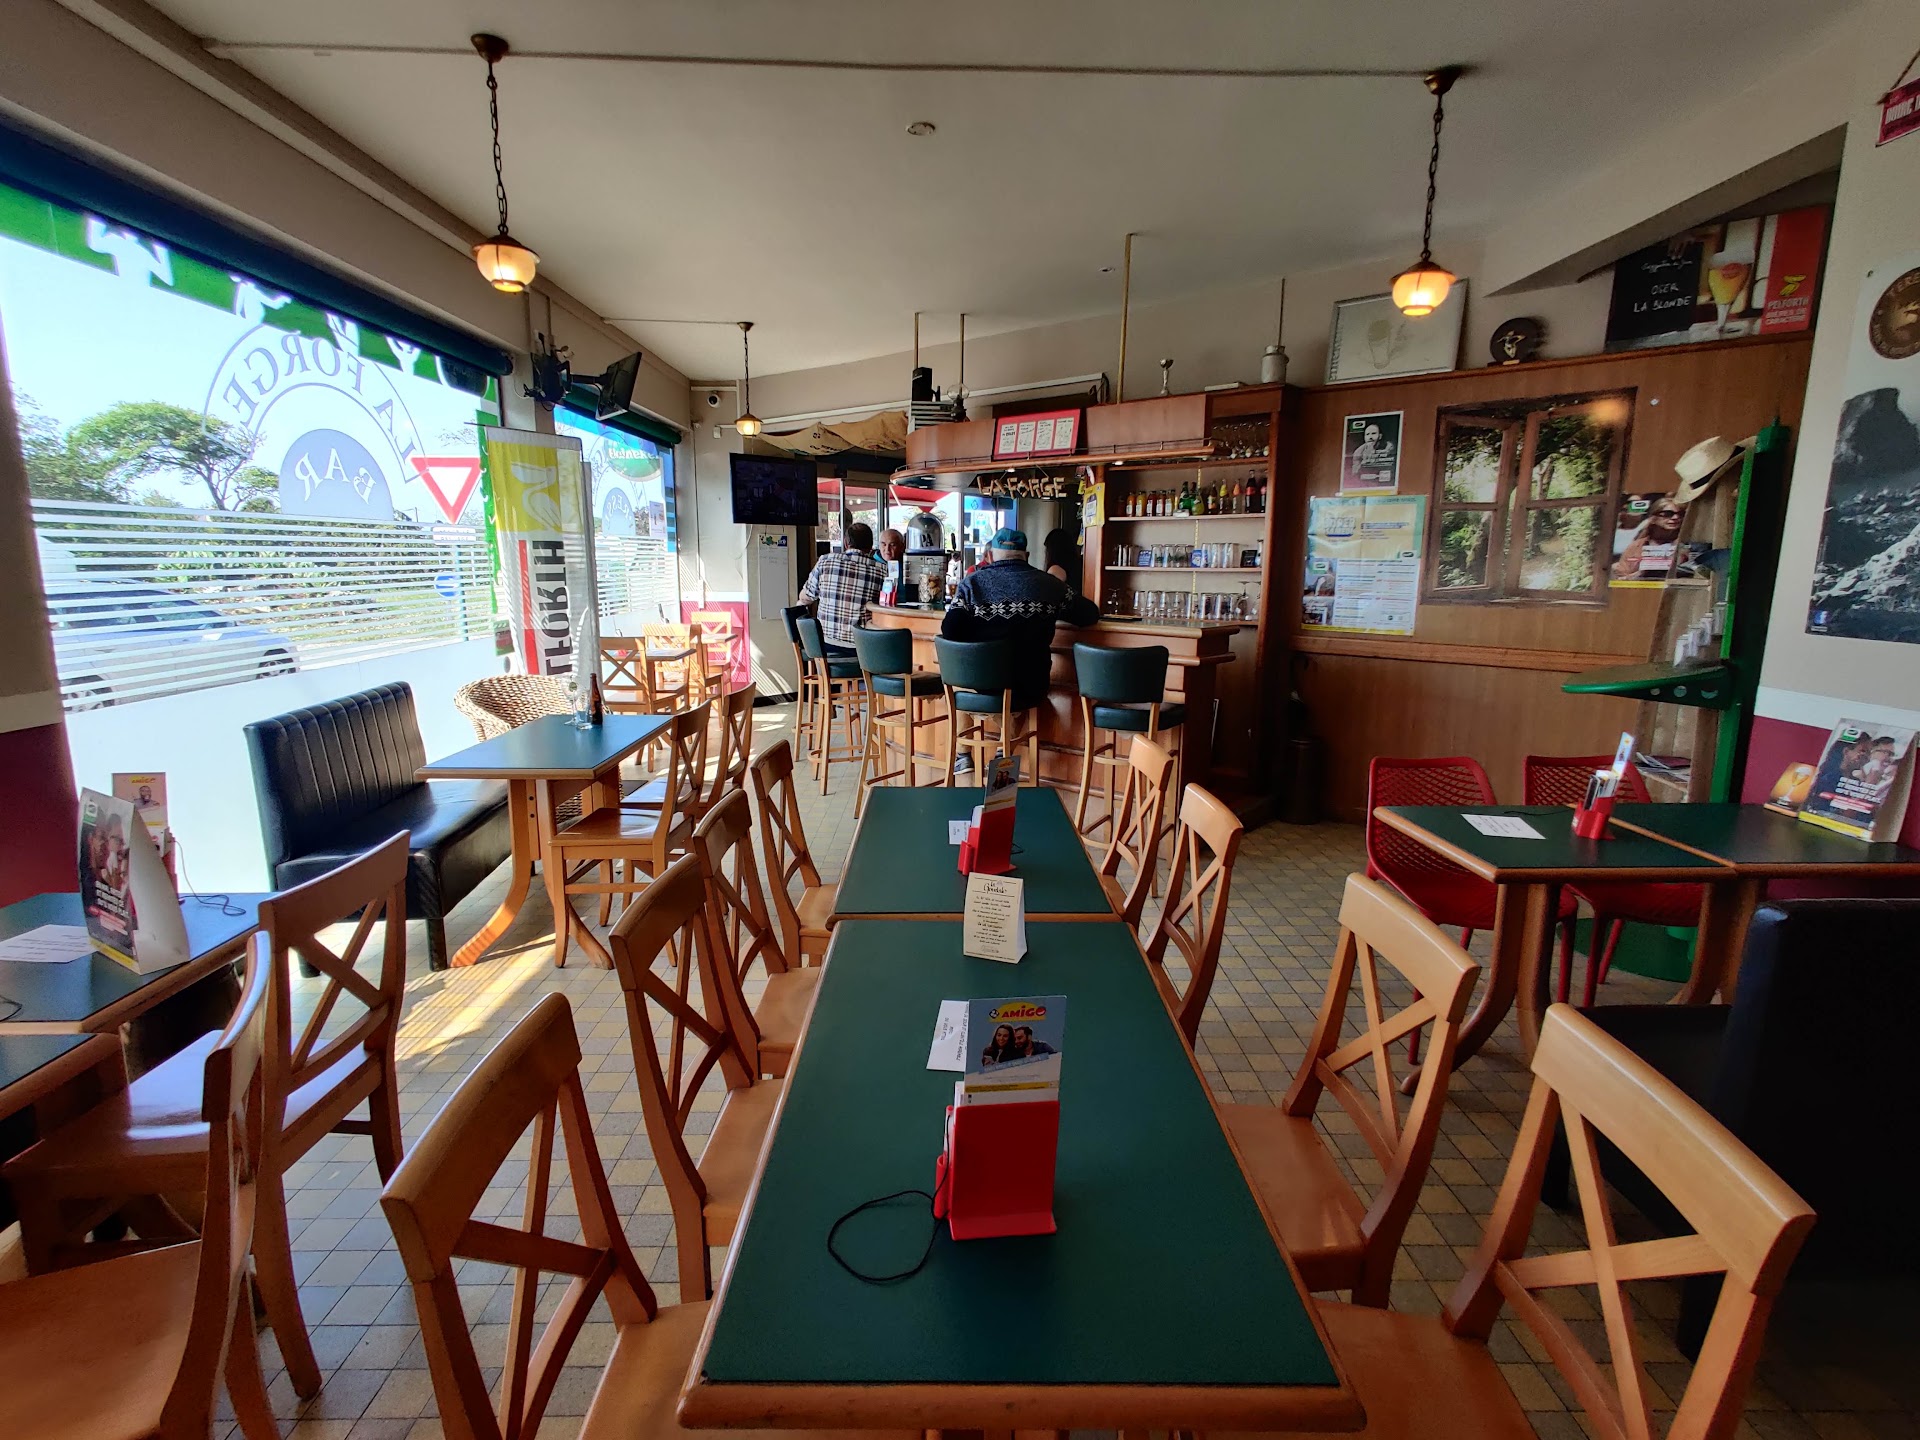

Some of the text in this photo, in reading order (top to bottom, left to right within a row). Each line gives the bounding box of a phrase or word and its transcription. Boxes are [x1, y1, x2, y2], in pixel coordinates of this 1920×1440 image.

[1634, 296, 1692, 312] LA BLONDE
[977, 475, 1068, 499] LA FORGE
[1002, 1005, 1046, 1018] AMIGO
